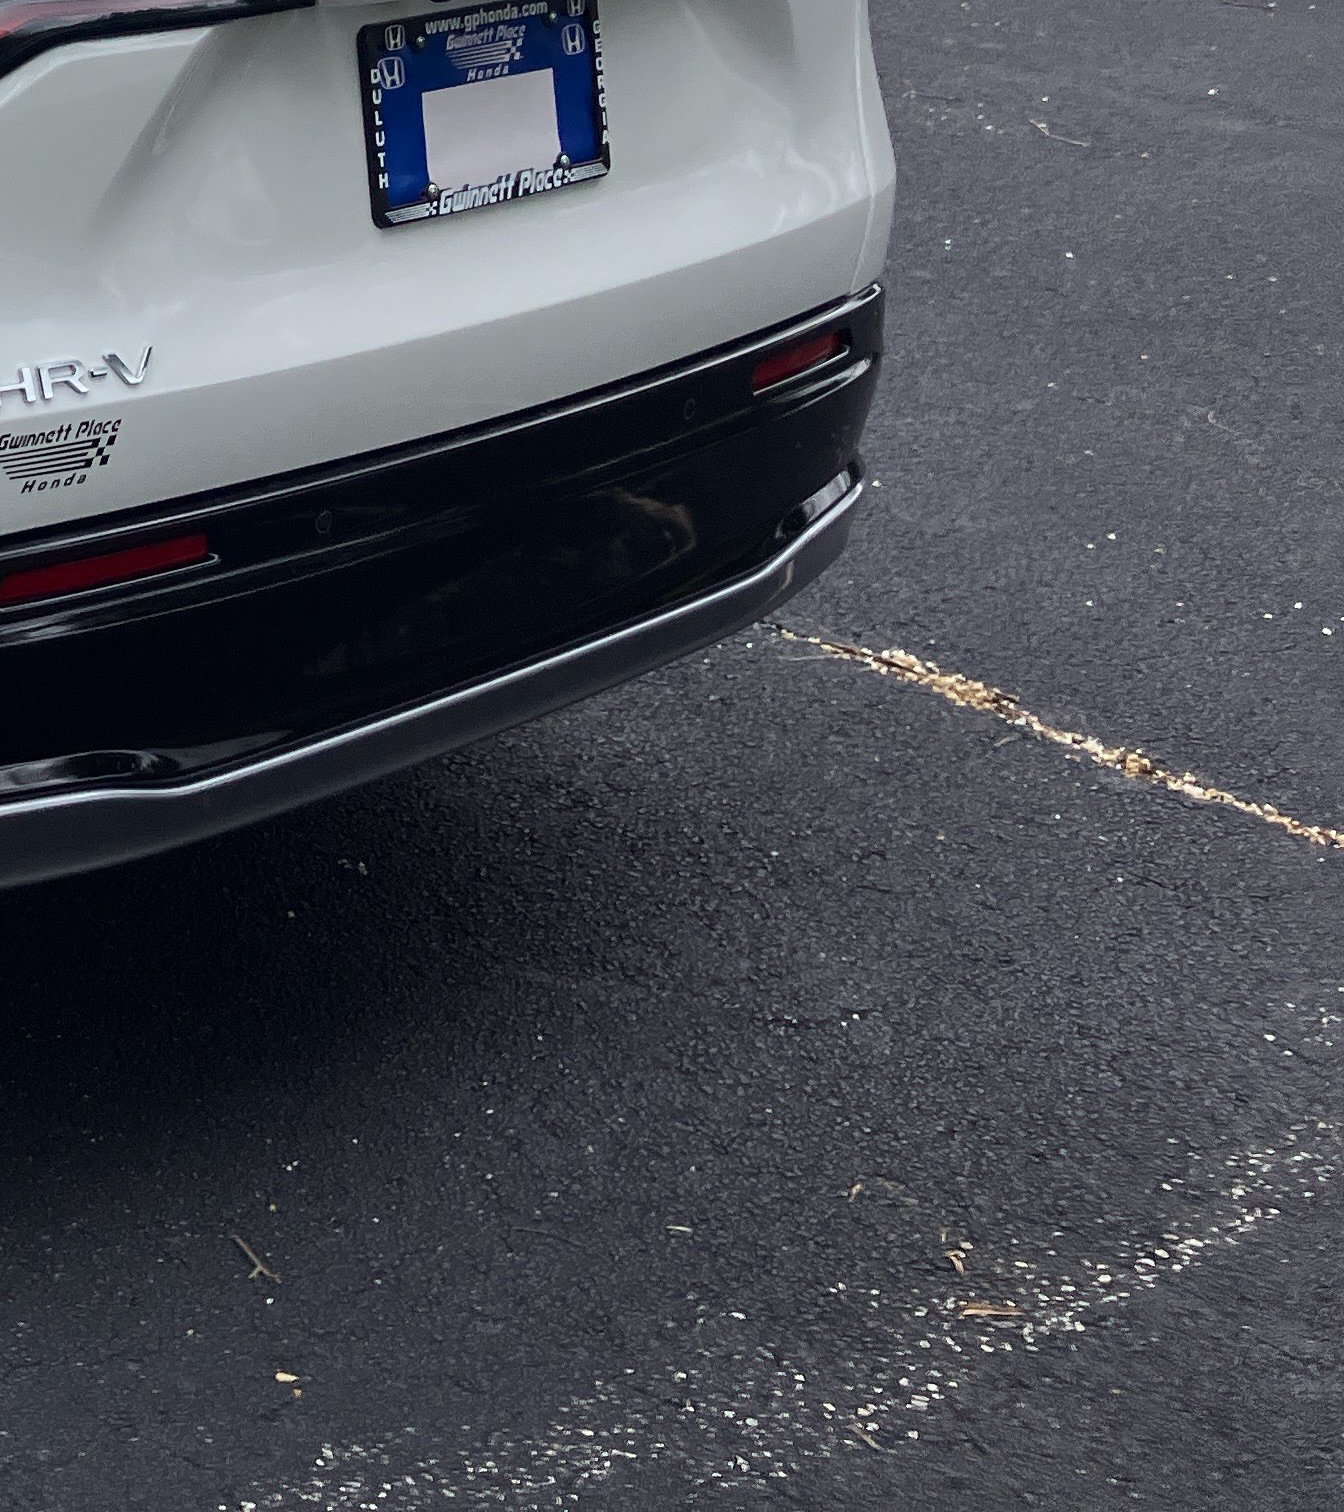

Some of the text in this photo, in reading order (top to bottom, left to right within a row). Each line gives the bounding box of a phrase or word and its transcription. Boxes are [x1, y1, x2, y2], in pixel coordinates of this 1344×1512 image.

[425, 1, 548, 34] www.gphonda.com
[446, 25, 526, 49] Gwinnett Place
[467, 64, 509, 82] Honda
[370, 68, 390, 189] DULUTH
[439, 168, 563, 215] Gwinnett Place
[75, 419, 122, 439] Place
[21, 473, 87, 494] Honda
